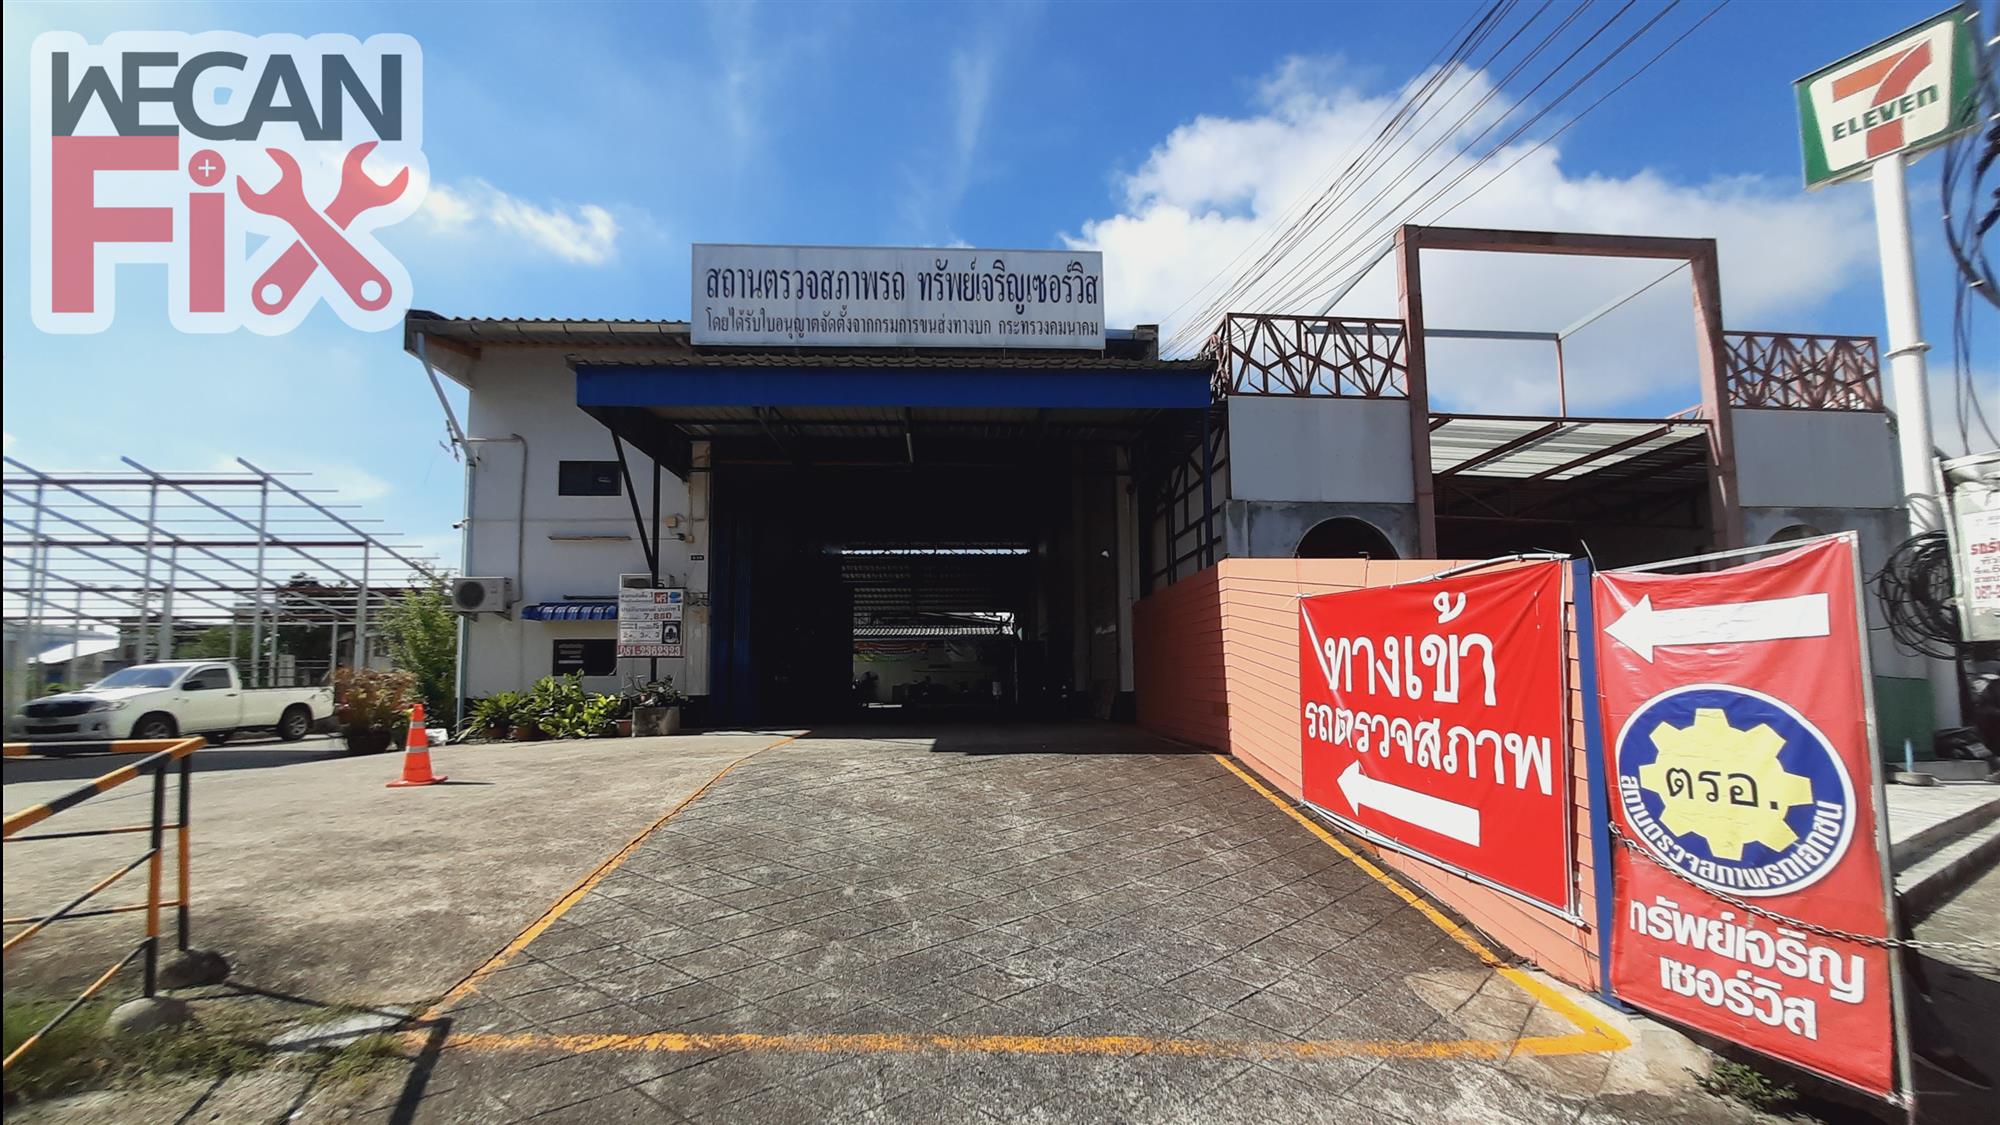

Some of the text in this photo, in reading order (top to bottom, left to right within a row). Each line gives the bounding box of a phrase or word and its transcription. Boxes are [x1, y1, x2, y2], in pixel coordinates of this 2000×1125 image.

[705, 257, 1099, 315] สถานตรวจสภาพรถ ทรัพย์เจริญเซอร์วิส
[705, 304, 1099, 339] โดยได้รับใบอนุญาตจัดตั้งจากกรมการขนส่งทางบก กระทรวงคมนาคม
[1323, 591, 1497, 706] ทางเข้า
[1304, 702, 1553, 796] รถตรวจสภาพ
[1666, 767, 1779, 810] ตรอ.
[1620, 775, 1843, 888] สถานตรวจสภาพรถเอกชน
[1629, 895, 1865, 1004] ทรัพย์เจริญ
[1659, 956, 1818, 1040] เซอร์วิส
